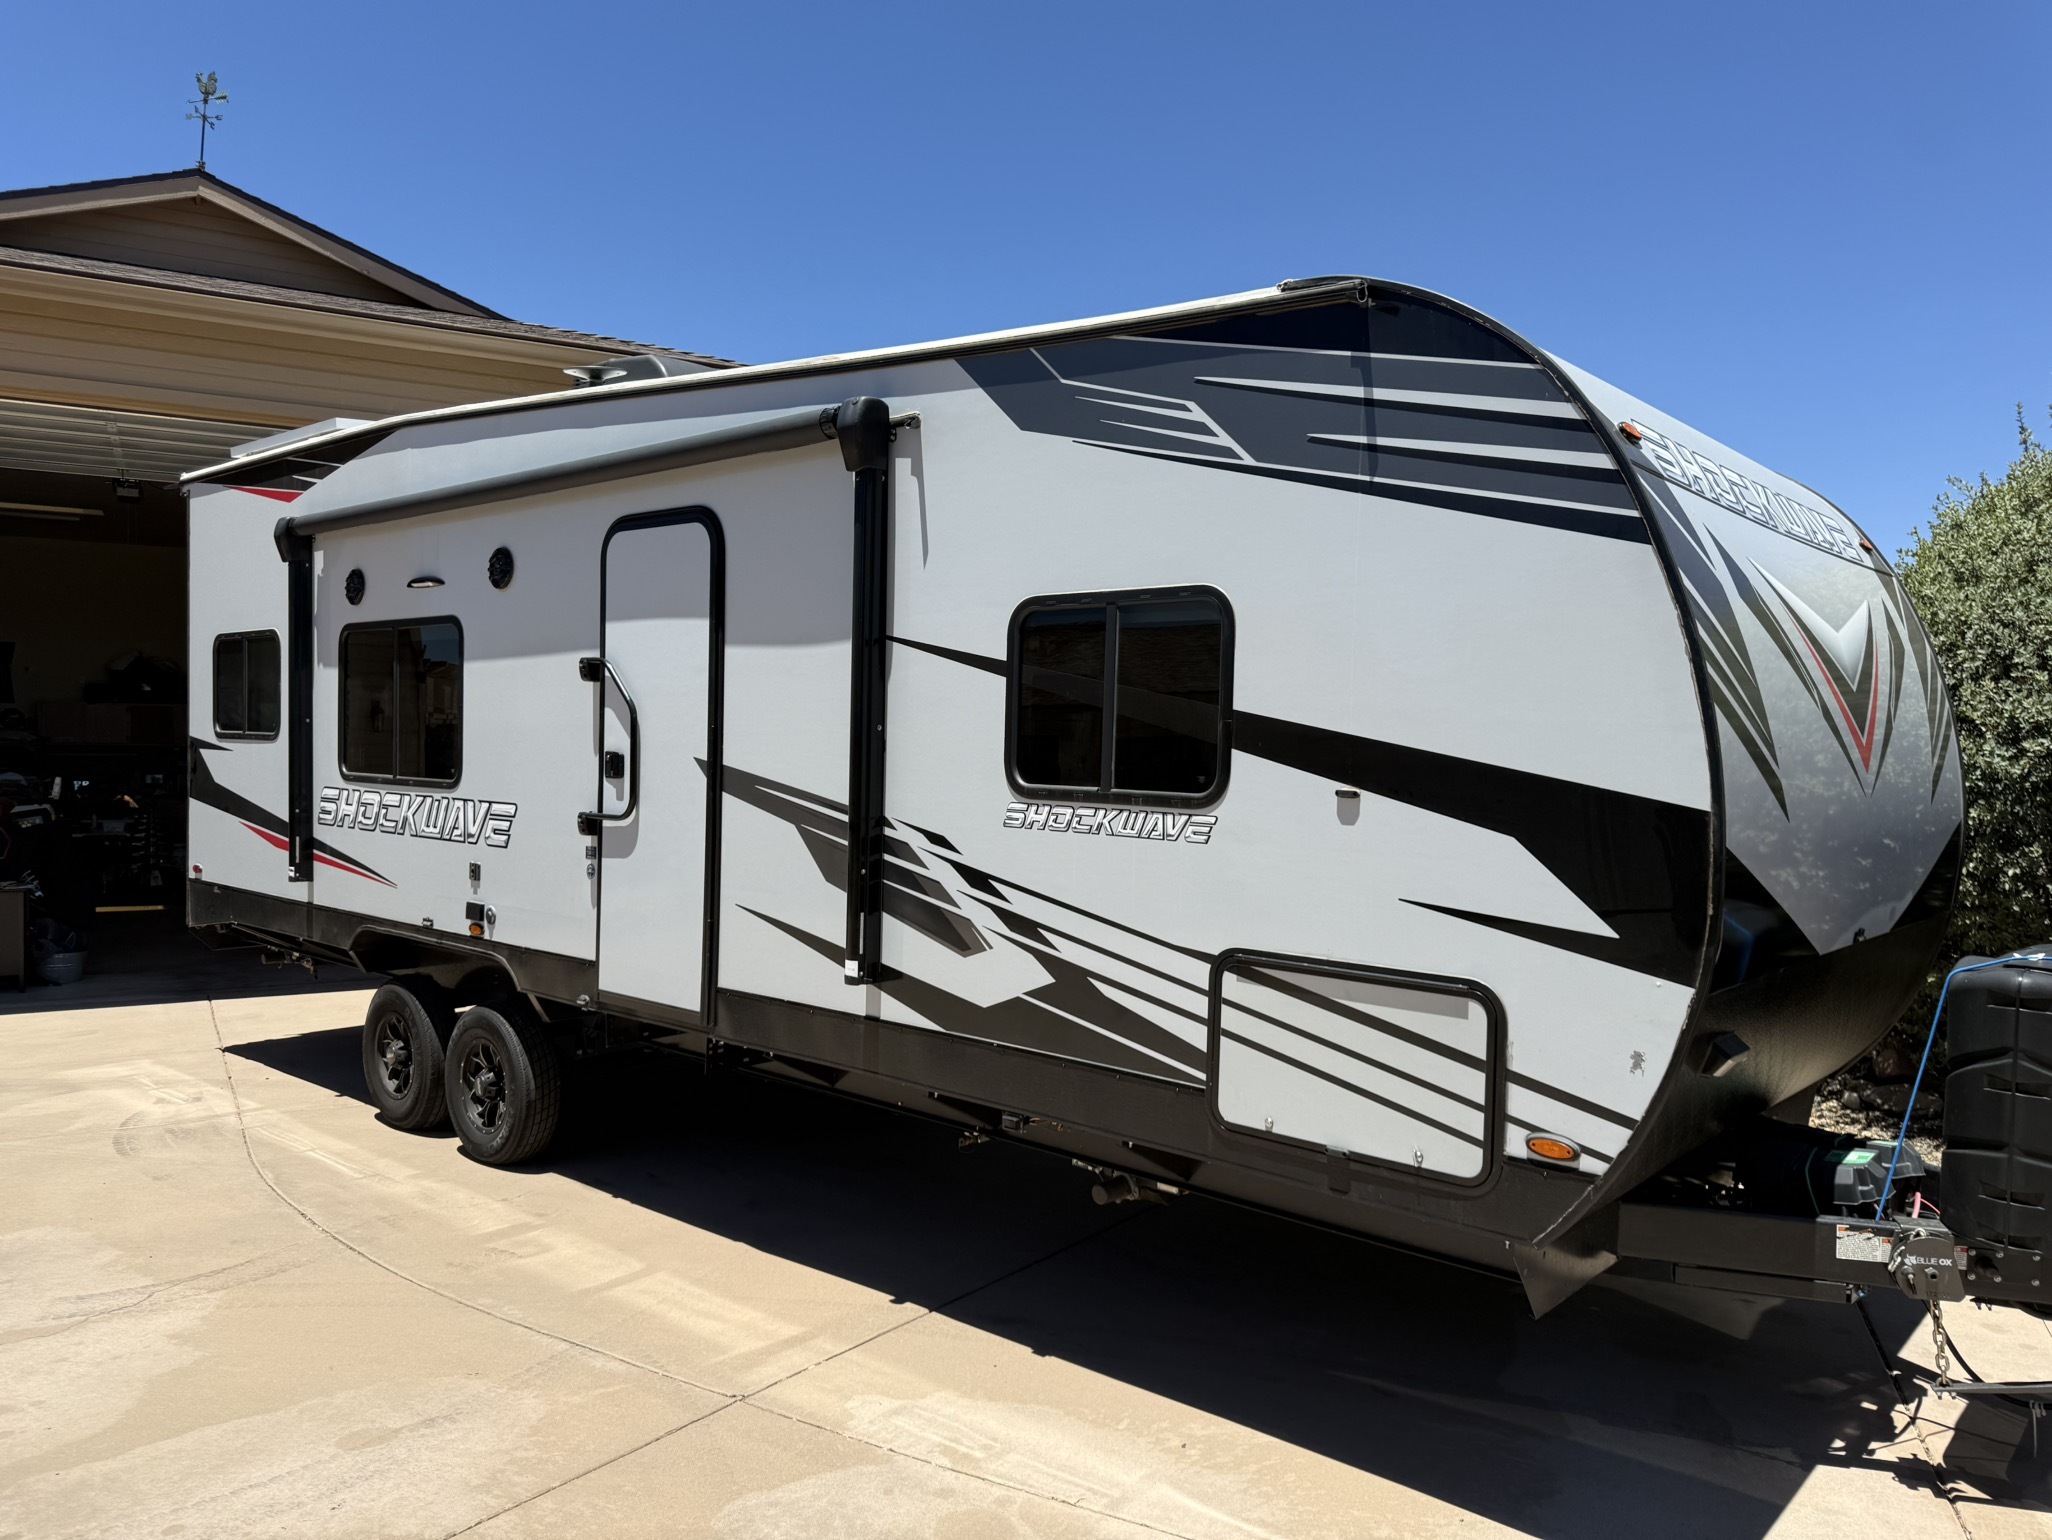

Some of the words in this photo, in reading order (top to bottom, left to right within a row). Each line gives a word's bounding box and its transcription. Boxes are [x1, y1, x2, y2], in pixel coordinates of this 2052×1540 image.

[1630, 418, 1864, 563] SHOCKWAVE
[318, 786, 517, 848] SHOCKWAVE
[1003, 801, 1218, 844] SHOCKWAVE
[1917, 1257, 1938, 1265] BLUE
[1939, 1258, 1952, 1266] OX
